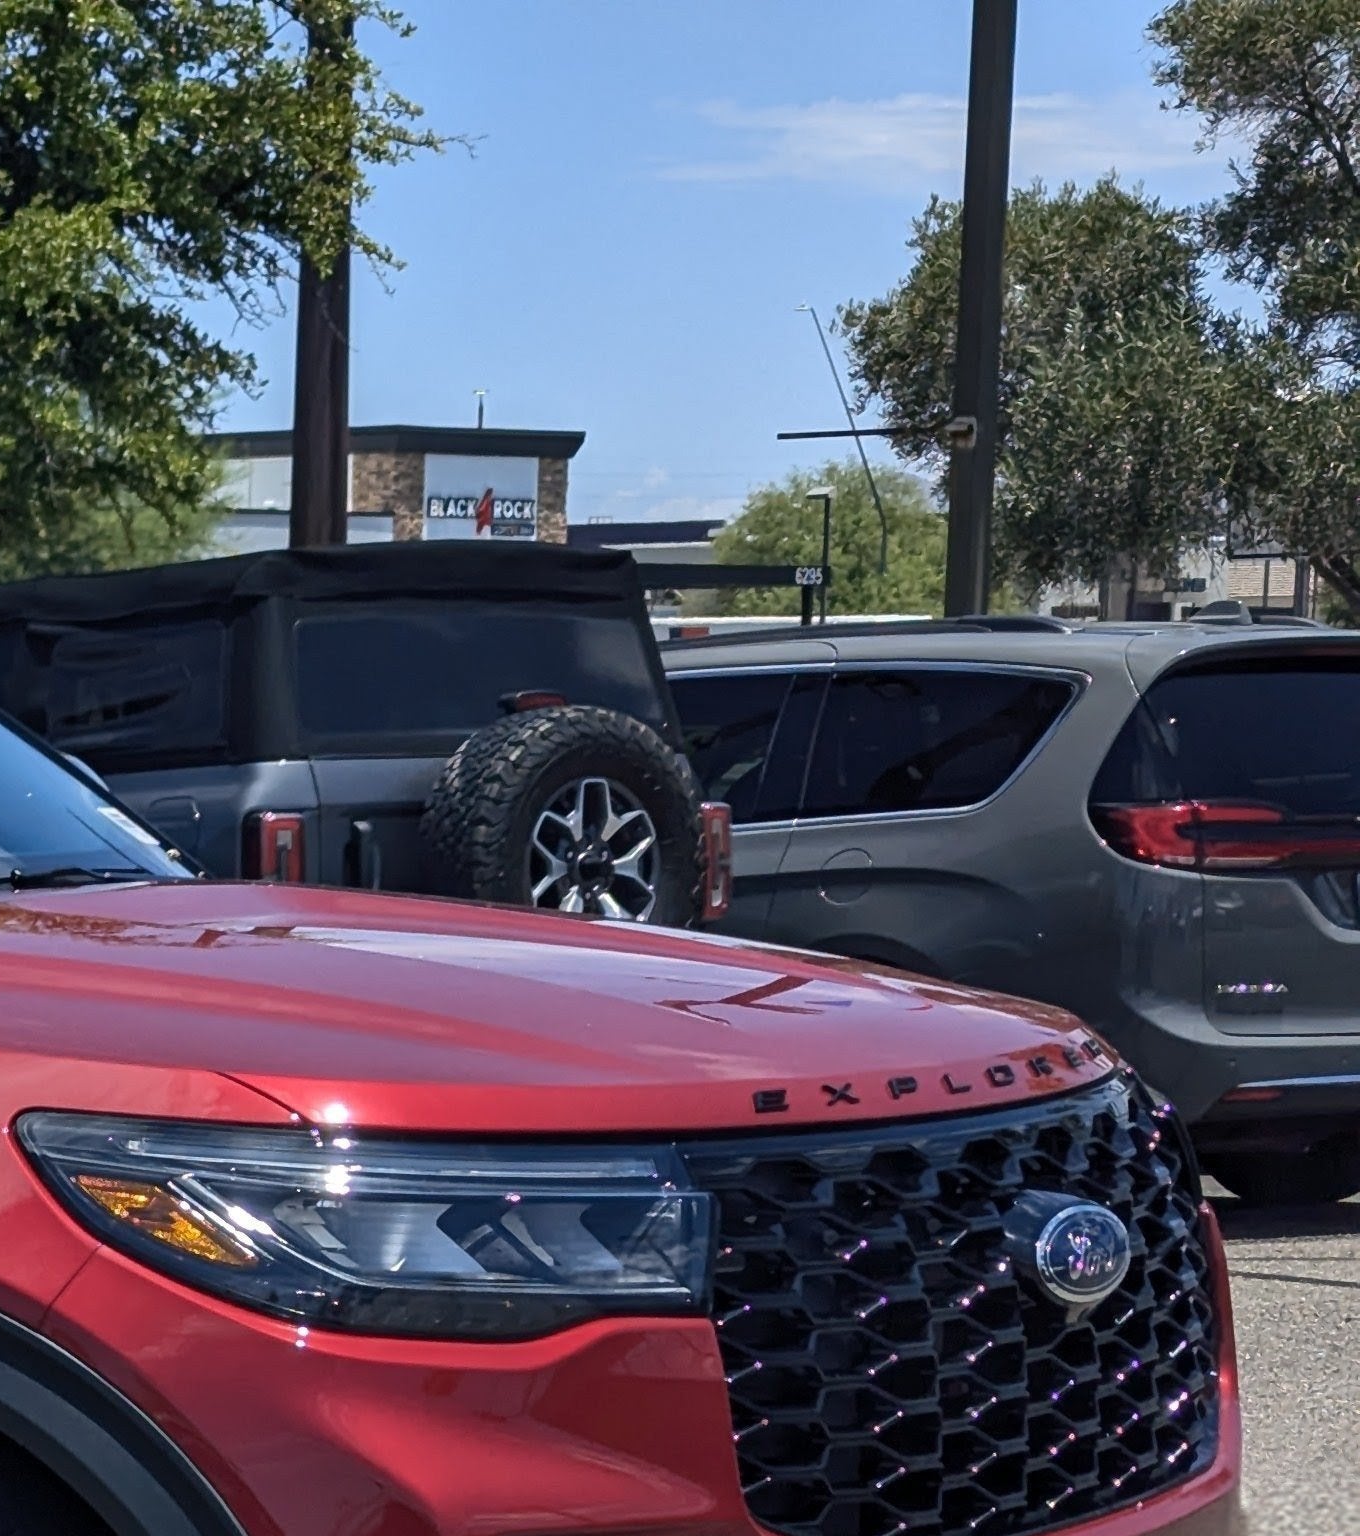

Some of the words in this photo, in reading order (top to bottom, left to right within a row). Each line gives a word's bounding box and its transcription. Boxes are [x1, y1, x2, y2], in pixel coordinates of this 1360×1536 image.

[429, 499, 476, 517] BLACK
[493, 500, 532, 519] ROCK
[752, 1039, 1106, 1114] EXPLORER
